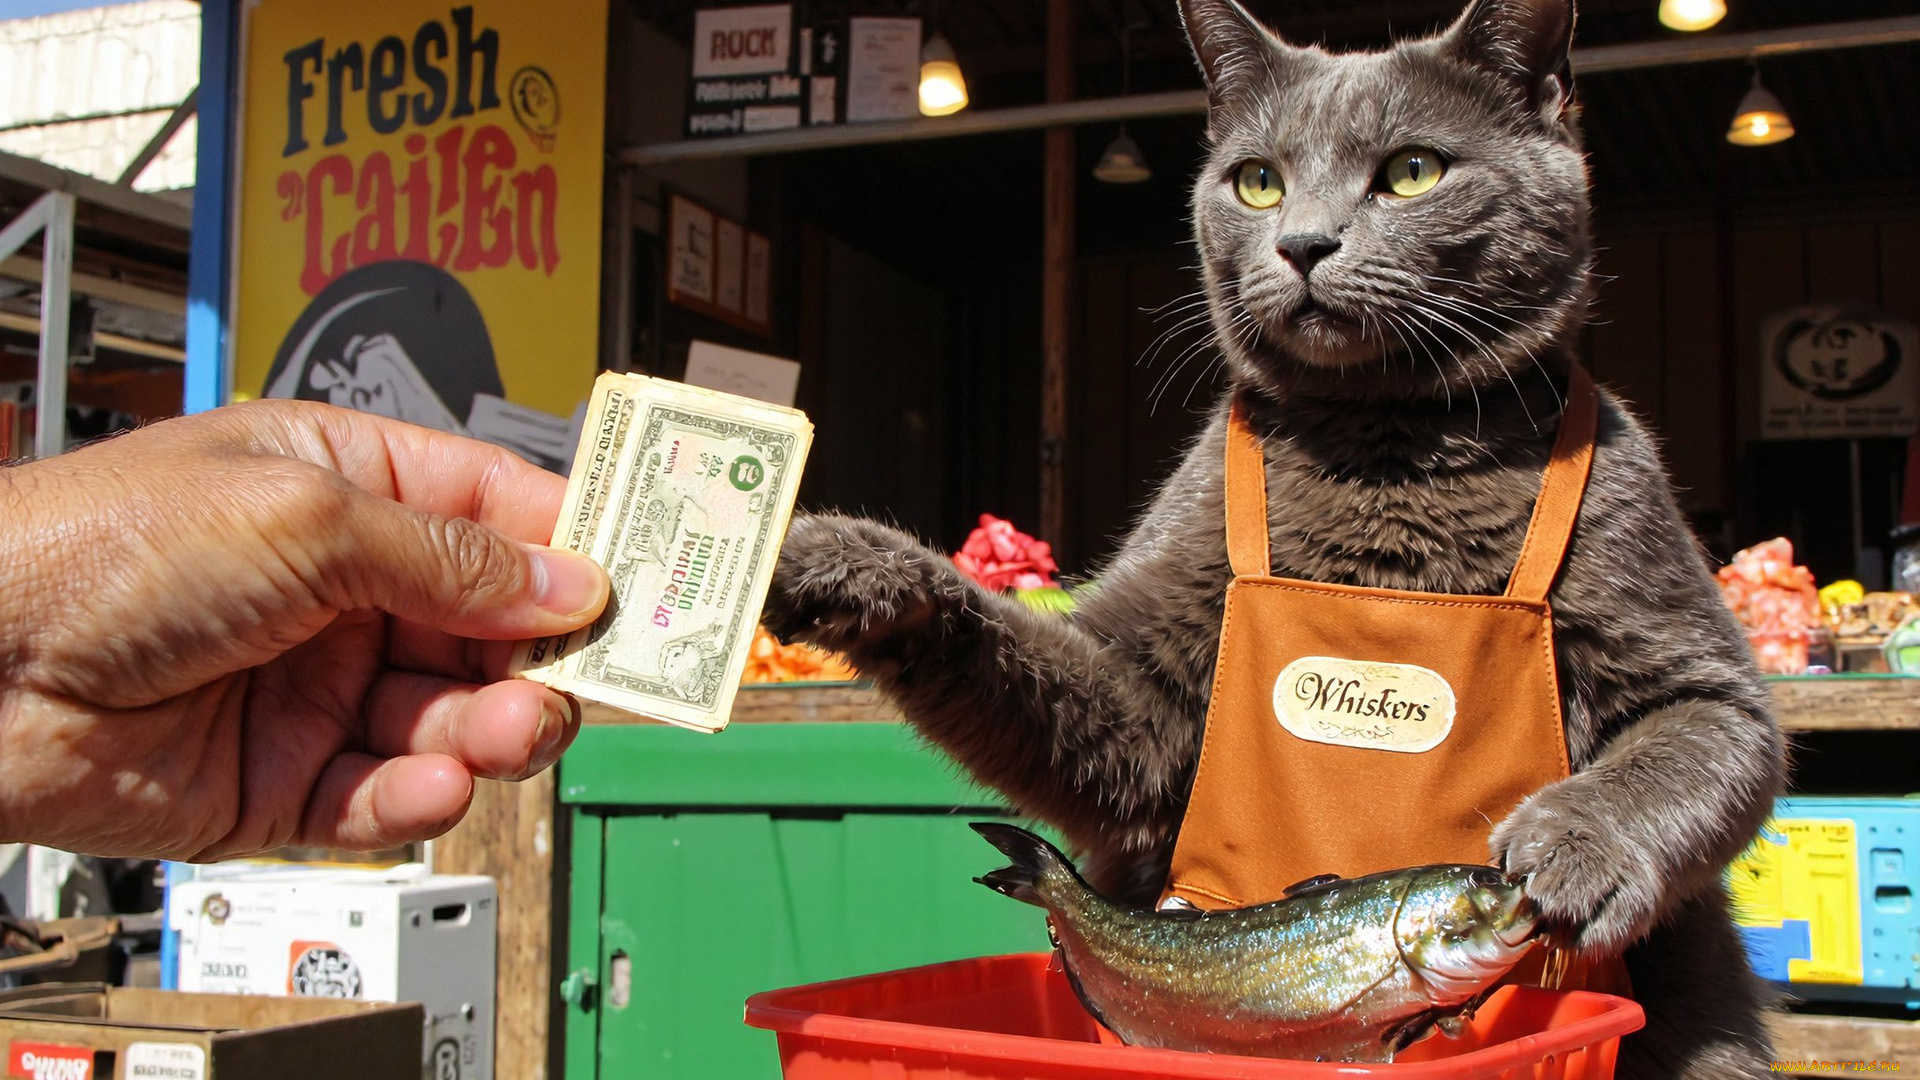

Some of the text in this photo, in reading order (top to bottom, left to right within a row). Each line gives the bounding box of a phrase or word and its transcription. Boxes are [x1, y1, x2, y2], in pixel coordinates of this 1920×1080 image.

[710, 26, 776, 61] ROCK
[282, 5, 501, 158] Fresh
[1295, 671, 1430, 722] Whiskers
